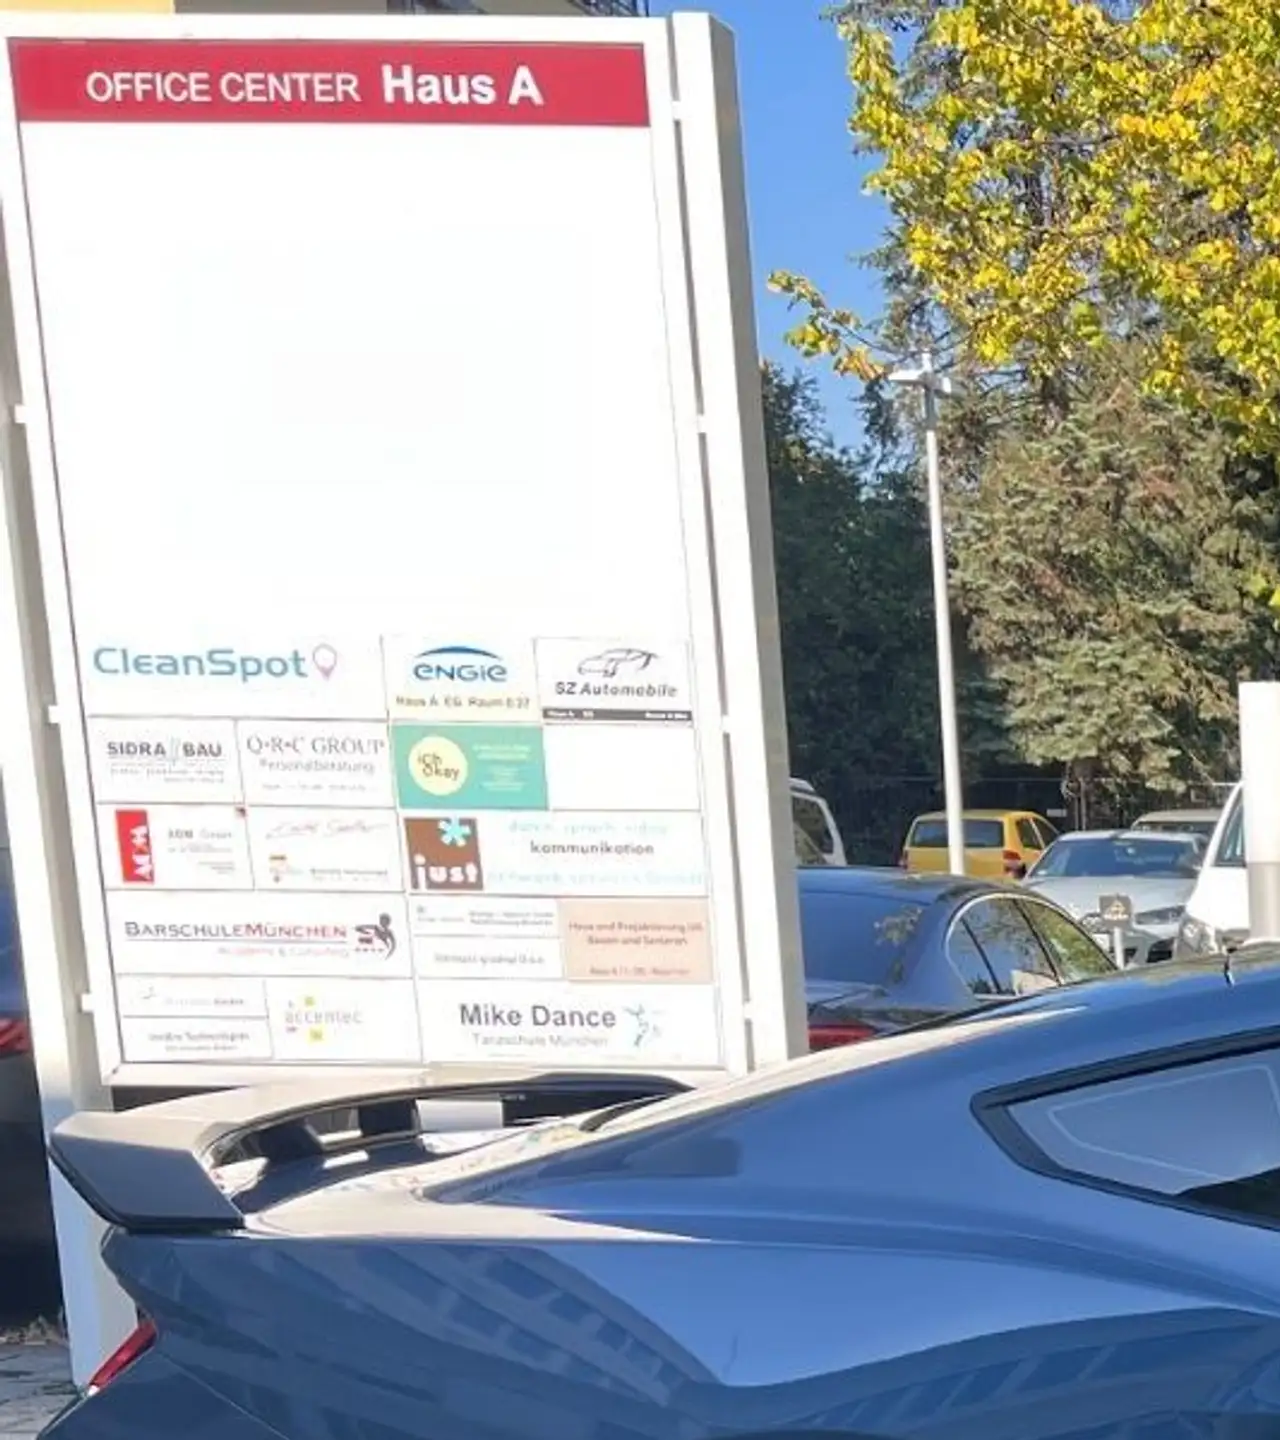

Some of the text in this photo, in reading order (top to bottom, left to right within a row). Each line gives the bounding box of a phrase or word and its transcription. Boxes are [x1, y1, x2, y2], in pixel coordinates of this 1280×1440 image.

[85, 64, 545, 106] OFFICE CENTER Haus A
[93, 646, 308, 683] CleanSpot
[555, 681, 678, 698] SZ Automobile
[107, 740, 222, 758] SIDRA BAU
[529, 840, 654, 856] kommunikation
[413, 853, 478, 889] just
[459, 1001, 617, 1029] Mike Dance
